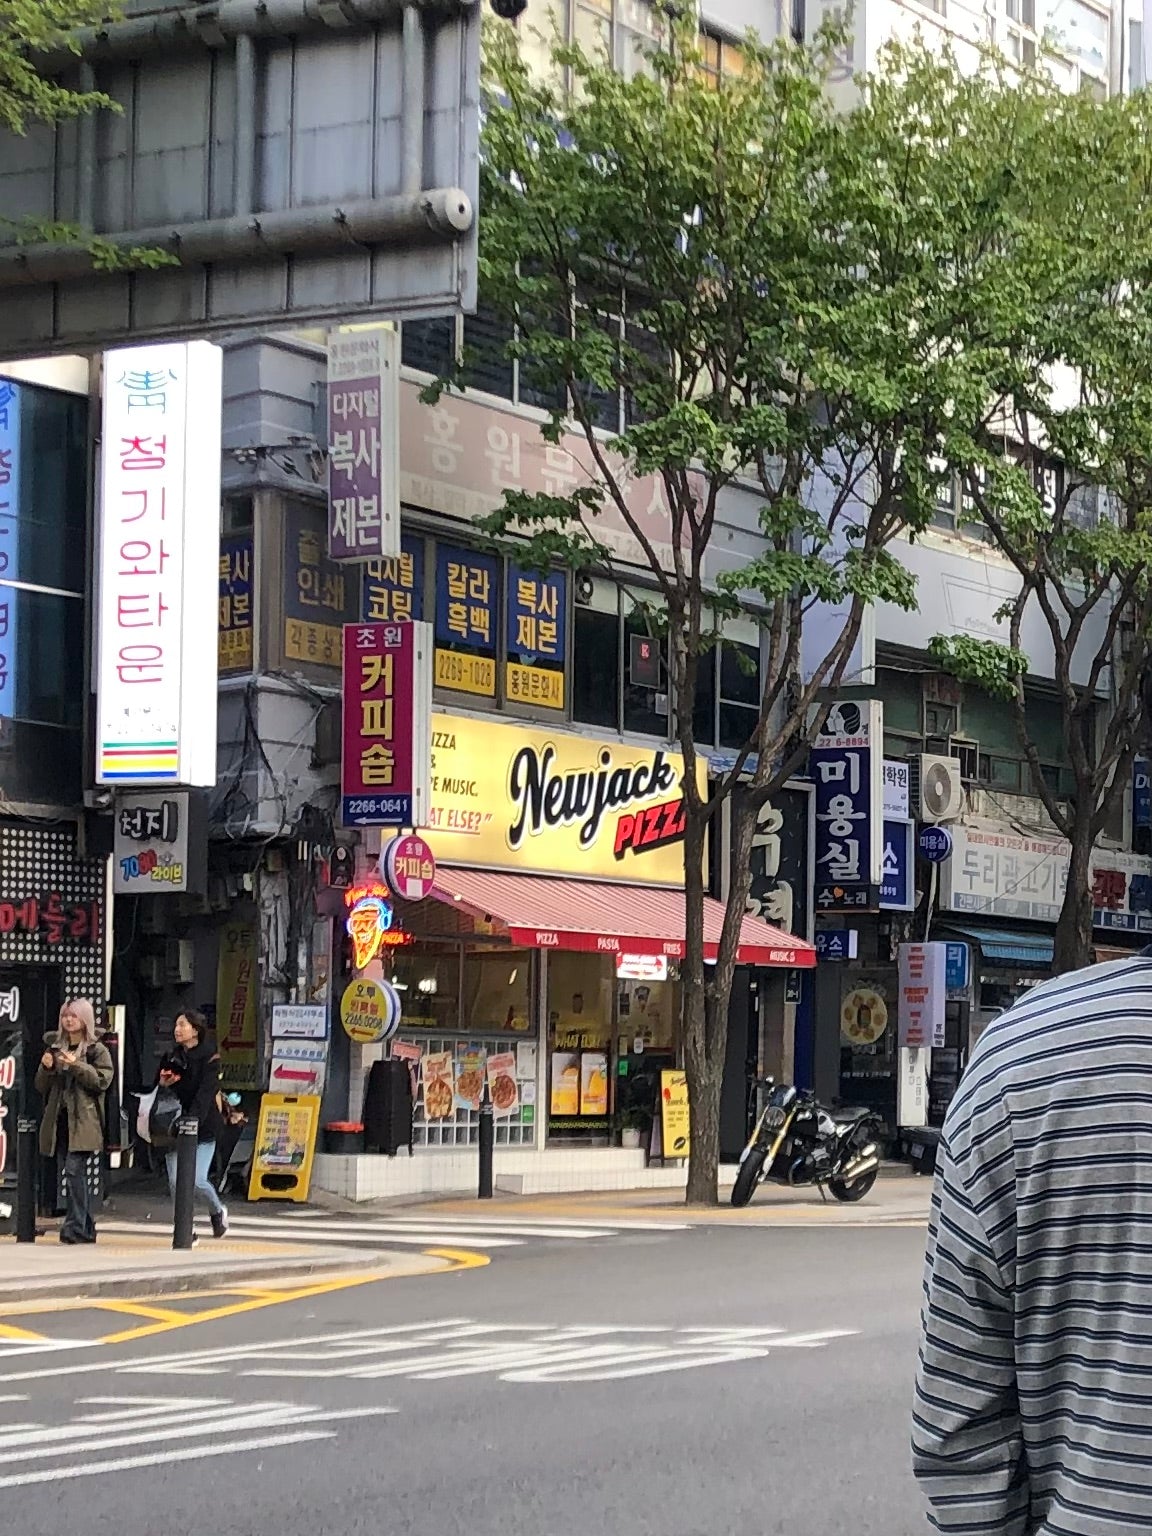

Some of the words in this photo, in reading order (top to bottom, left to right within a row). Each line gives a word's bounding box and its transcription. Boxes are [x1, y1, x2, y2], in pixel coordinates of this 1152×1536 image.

[332, 388, 380, 419] 디지털
[330, 427, 381, 481] 복사
[331, 493, 380, 548] 제본
[116, 433, 172, 685] 청기와타운
[447, 562, 491, 604] 칼라
[516, 578, 559, 620] 복사
[356, 626, 403, 648] 초원
[447, 602, 491, 643] 흑백
[516, 614, 557, 654] 제본
[359, 652, 395, 786] 커피숍
[508, 746, 676, 846] Newjack
[882, 765, 908, 790] 학원
[815, 752, 867, 881] 미용실
